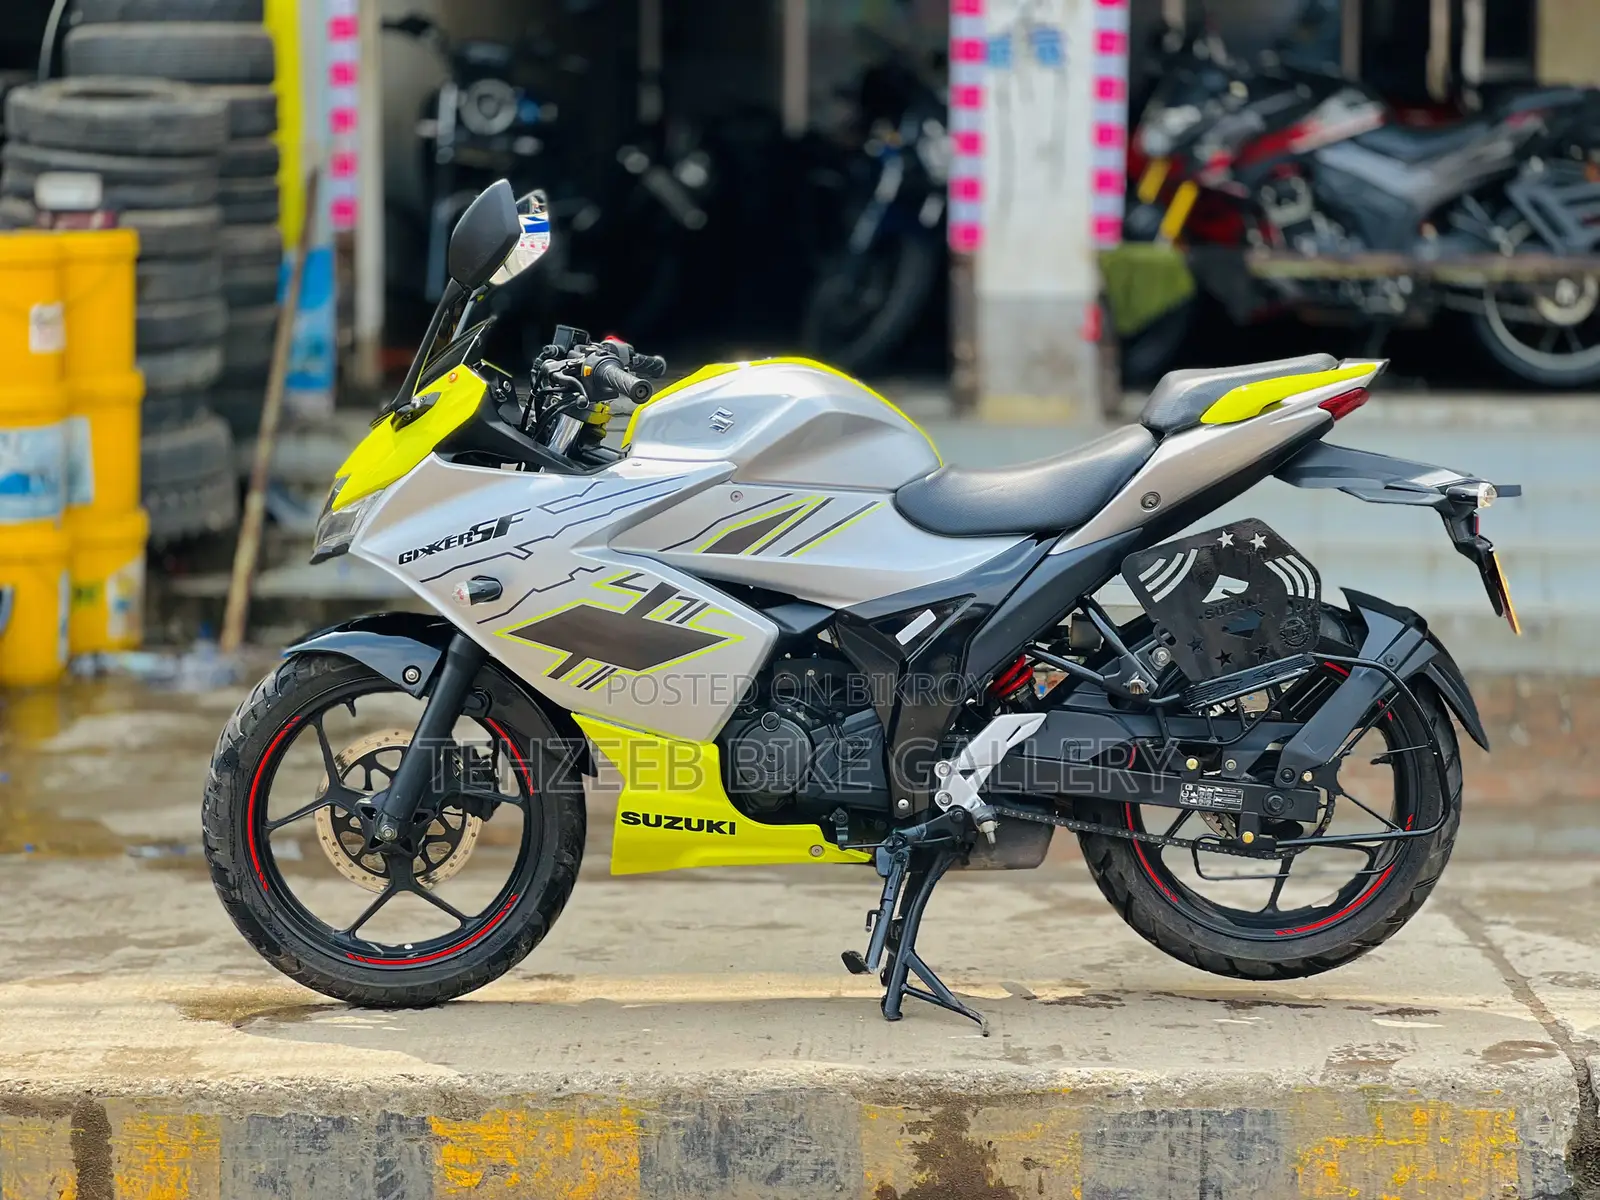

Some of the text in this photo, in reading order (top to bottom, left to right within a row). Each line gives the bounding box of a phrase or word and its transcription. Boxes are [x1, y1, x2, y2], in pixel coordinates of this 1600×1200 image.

[397, 507, 532, 566] GIXXER SF
[620, 811, 737, 836] SUZUKI
